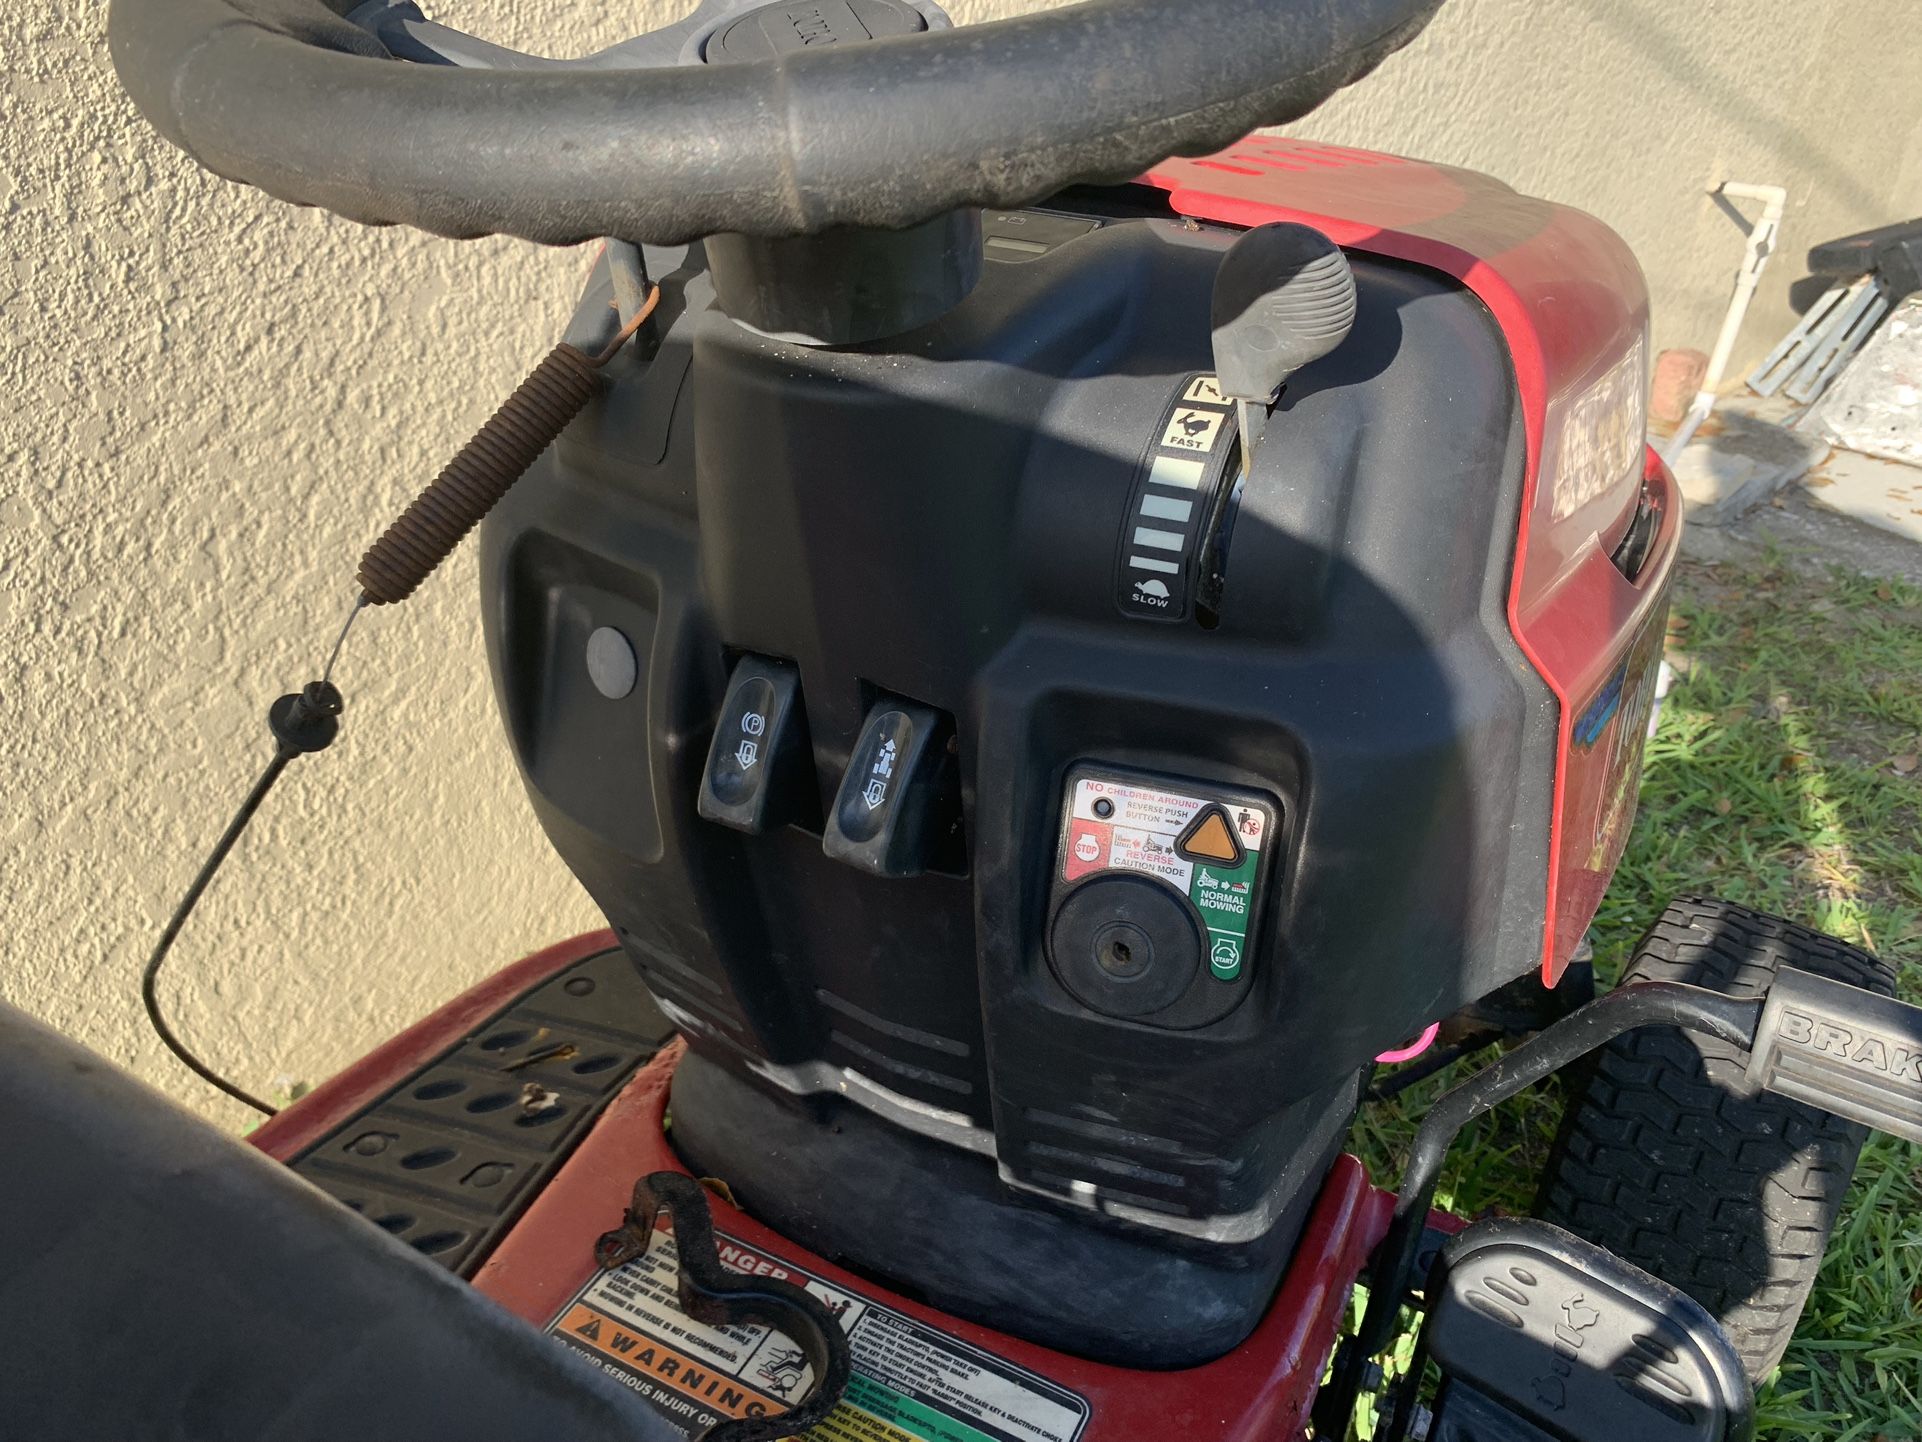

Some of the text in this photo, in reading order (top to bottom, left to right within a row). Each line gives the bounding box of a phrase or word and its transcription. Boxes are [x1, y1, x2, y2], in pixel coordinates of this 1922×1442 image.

[1170, 436, 1203, 449] FAST
[1132, 593, 1169, 608] SLOW
[1086, 781, 1199, 809] NO CHILDREN AROUND
[1126, 811, 1160, 823] BUTTON
[1127, 801, 1189, 818] REVERSE PUSH
[1076, 842, 1097, 855] STOP
[1126, 850, 1175, 865] REVERSE
[1114, 857, 1185, 877] CAUTION MODE
[1201, 889, 1246, 906] NORMAL
[1200, 898, 1244, 914] MOWING
[1215, 956, 1234, 965] START
[876, 1313, 915, 1334] TO START
[670, 1325, 686, 1339] NOT
[610, 1331, 767, 1418] WARNING
[601, 1363, 654, 1395] SERIOUS
[652, 1388, 699, 1418] INJURY
[887, 1379, 917, 1397] MODES
